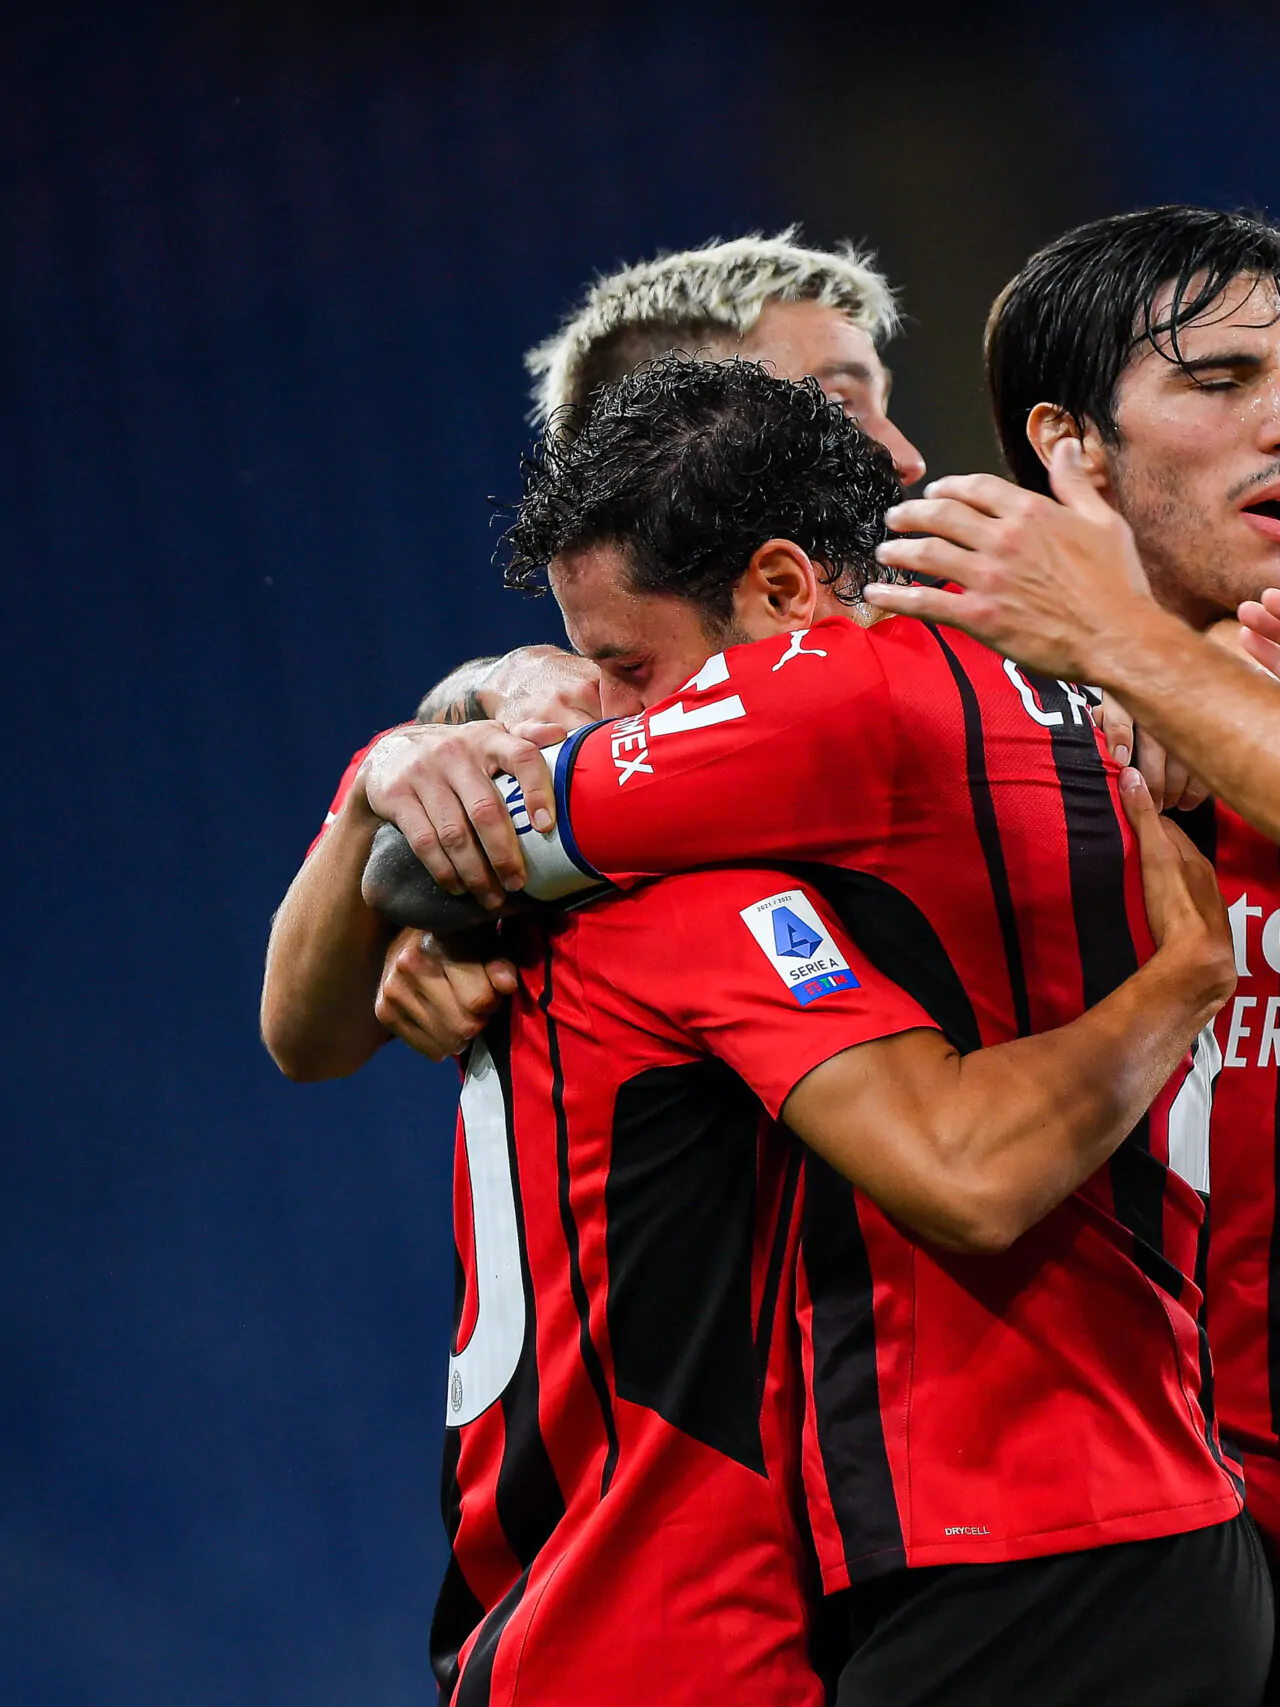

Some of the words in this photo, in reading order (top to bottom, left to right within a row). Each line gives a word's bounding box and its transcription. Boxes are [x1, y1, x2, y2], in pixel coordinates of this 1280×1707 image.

[789, 959, 828, 981] SERIE
[829, 957, 840, 969] A
[944, 1526, 991, 1536] DRYCELL
